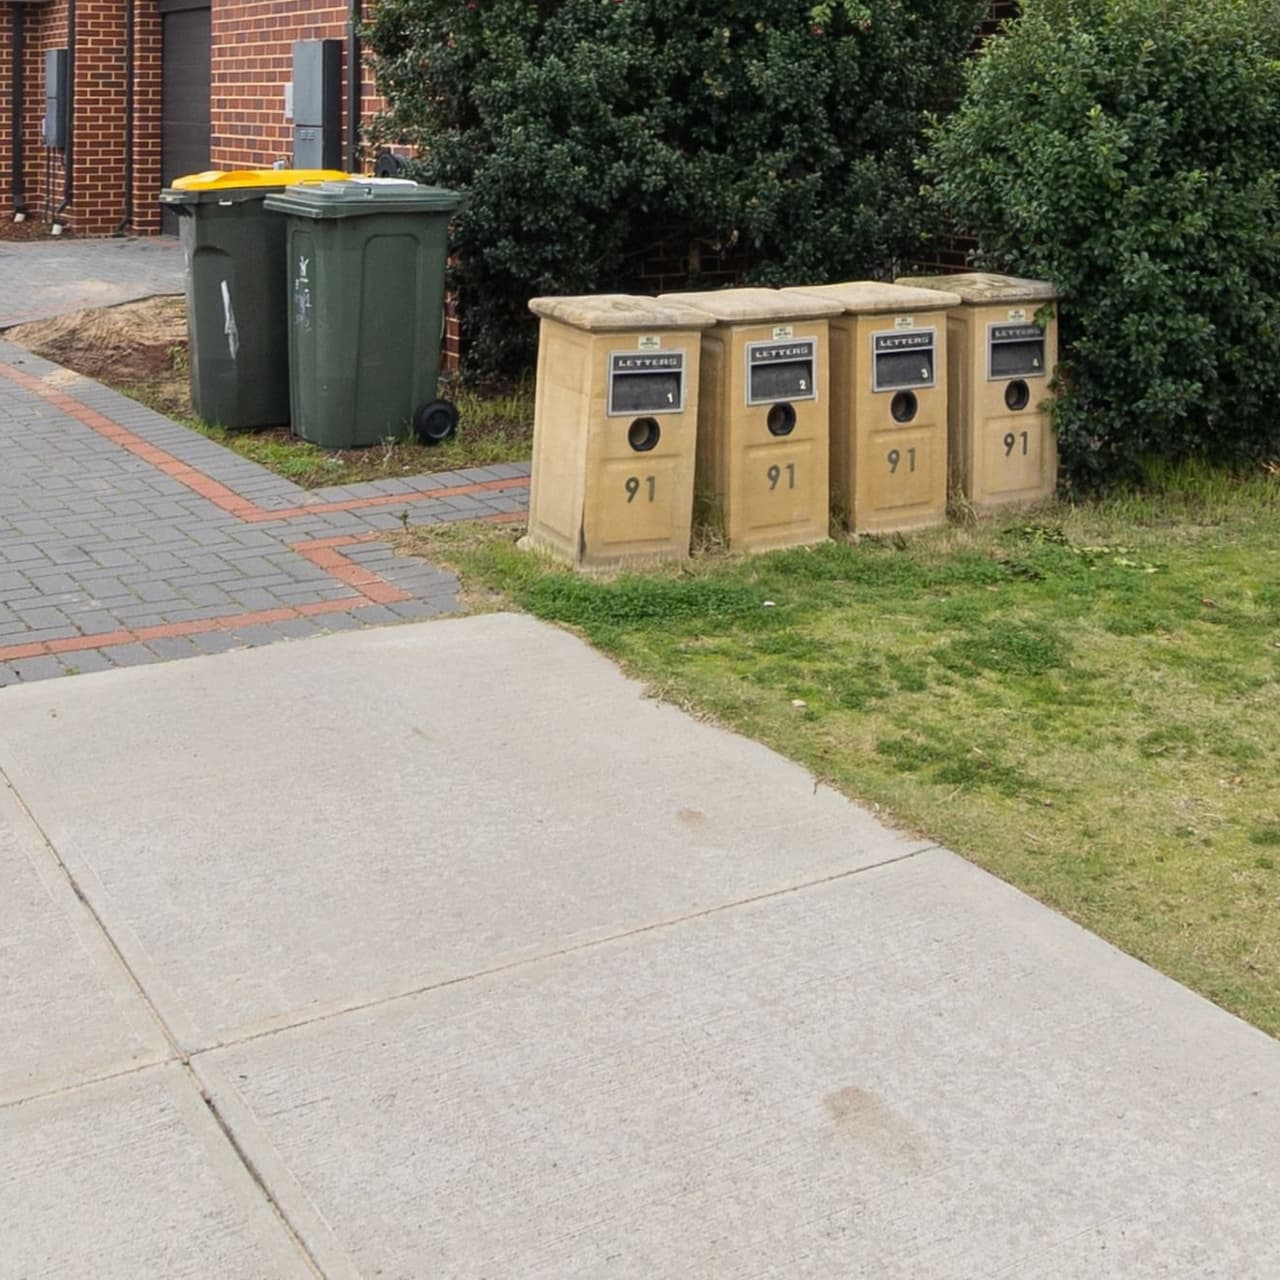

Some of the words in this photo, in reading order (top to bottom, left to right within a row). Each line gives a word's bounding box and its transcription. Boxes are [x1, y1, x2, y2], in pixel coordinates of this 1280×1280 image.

[879, 335, 929, 347] LETTERS
[755, 347, 808, 358] LETTERS
[618, 358, 678, 368] LETTERS
[921, 368, 929, 379] 3
[799, 380, 807, 390] 2
[667, 392, 674, 403] 1
[1003, 431, 1028, 456] 91
[887, 447, 916, 474] 91
[767, 463, 795, 490] 91
[625, 476, 656, 503] 91
